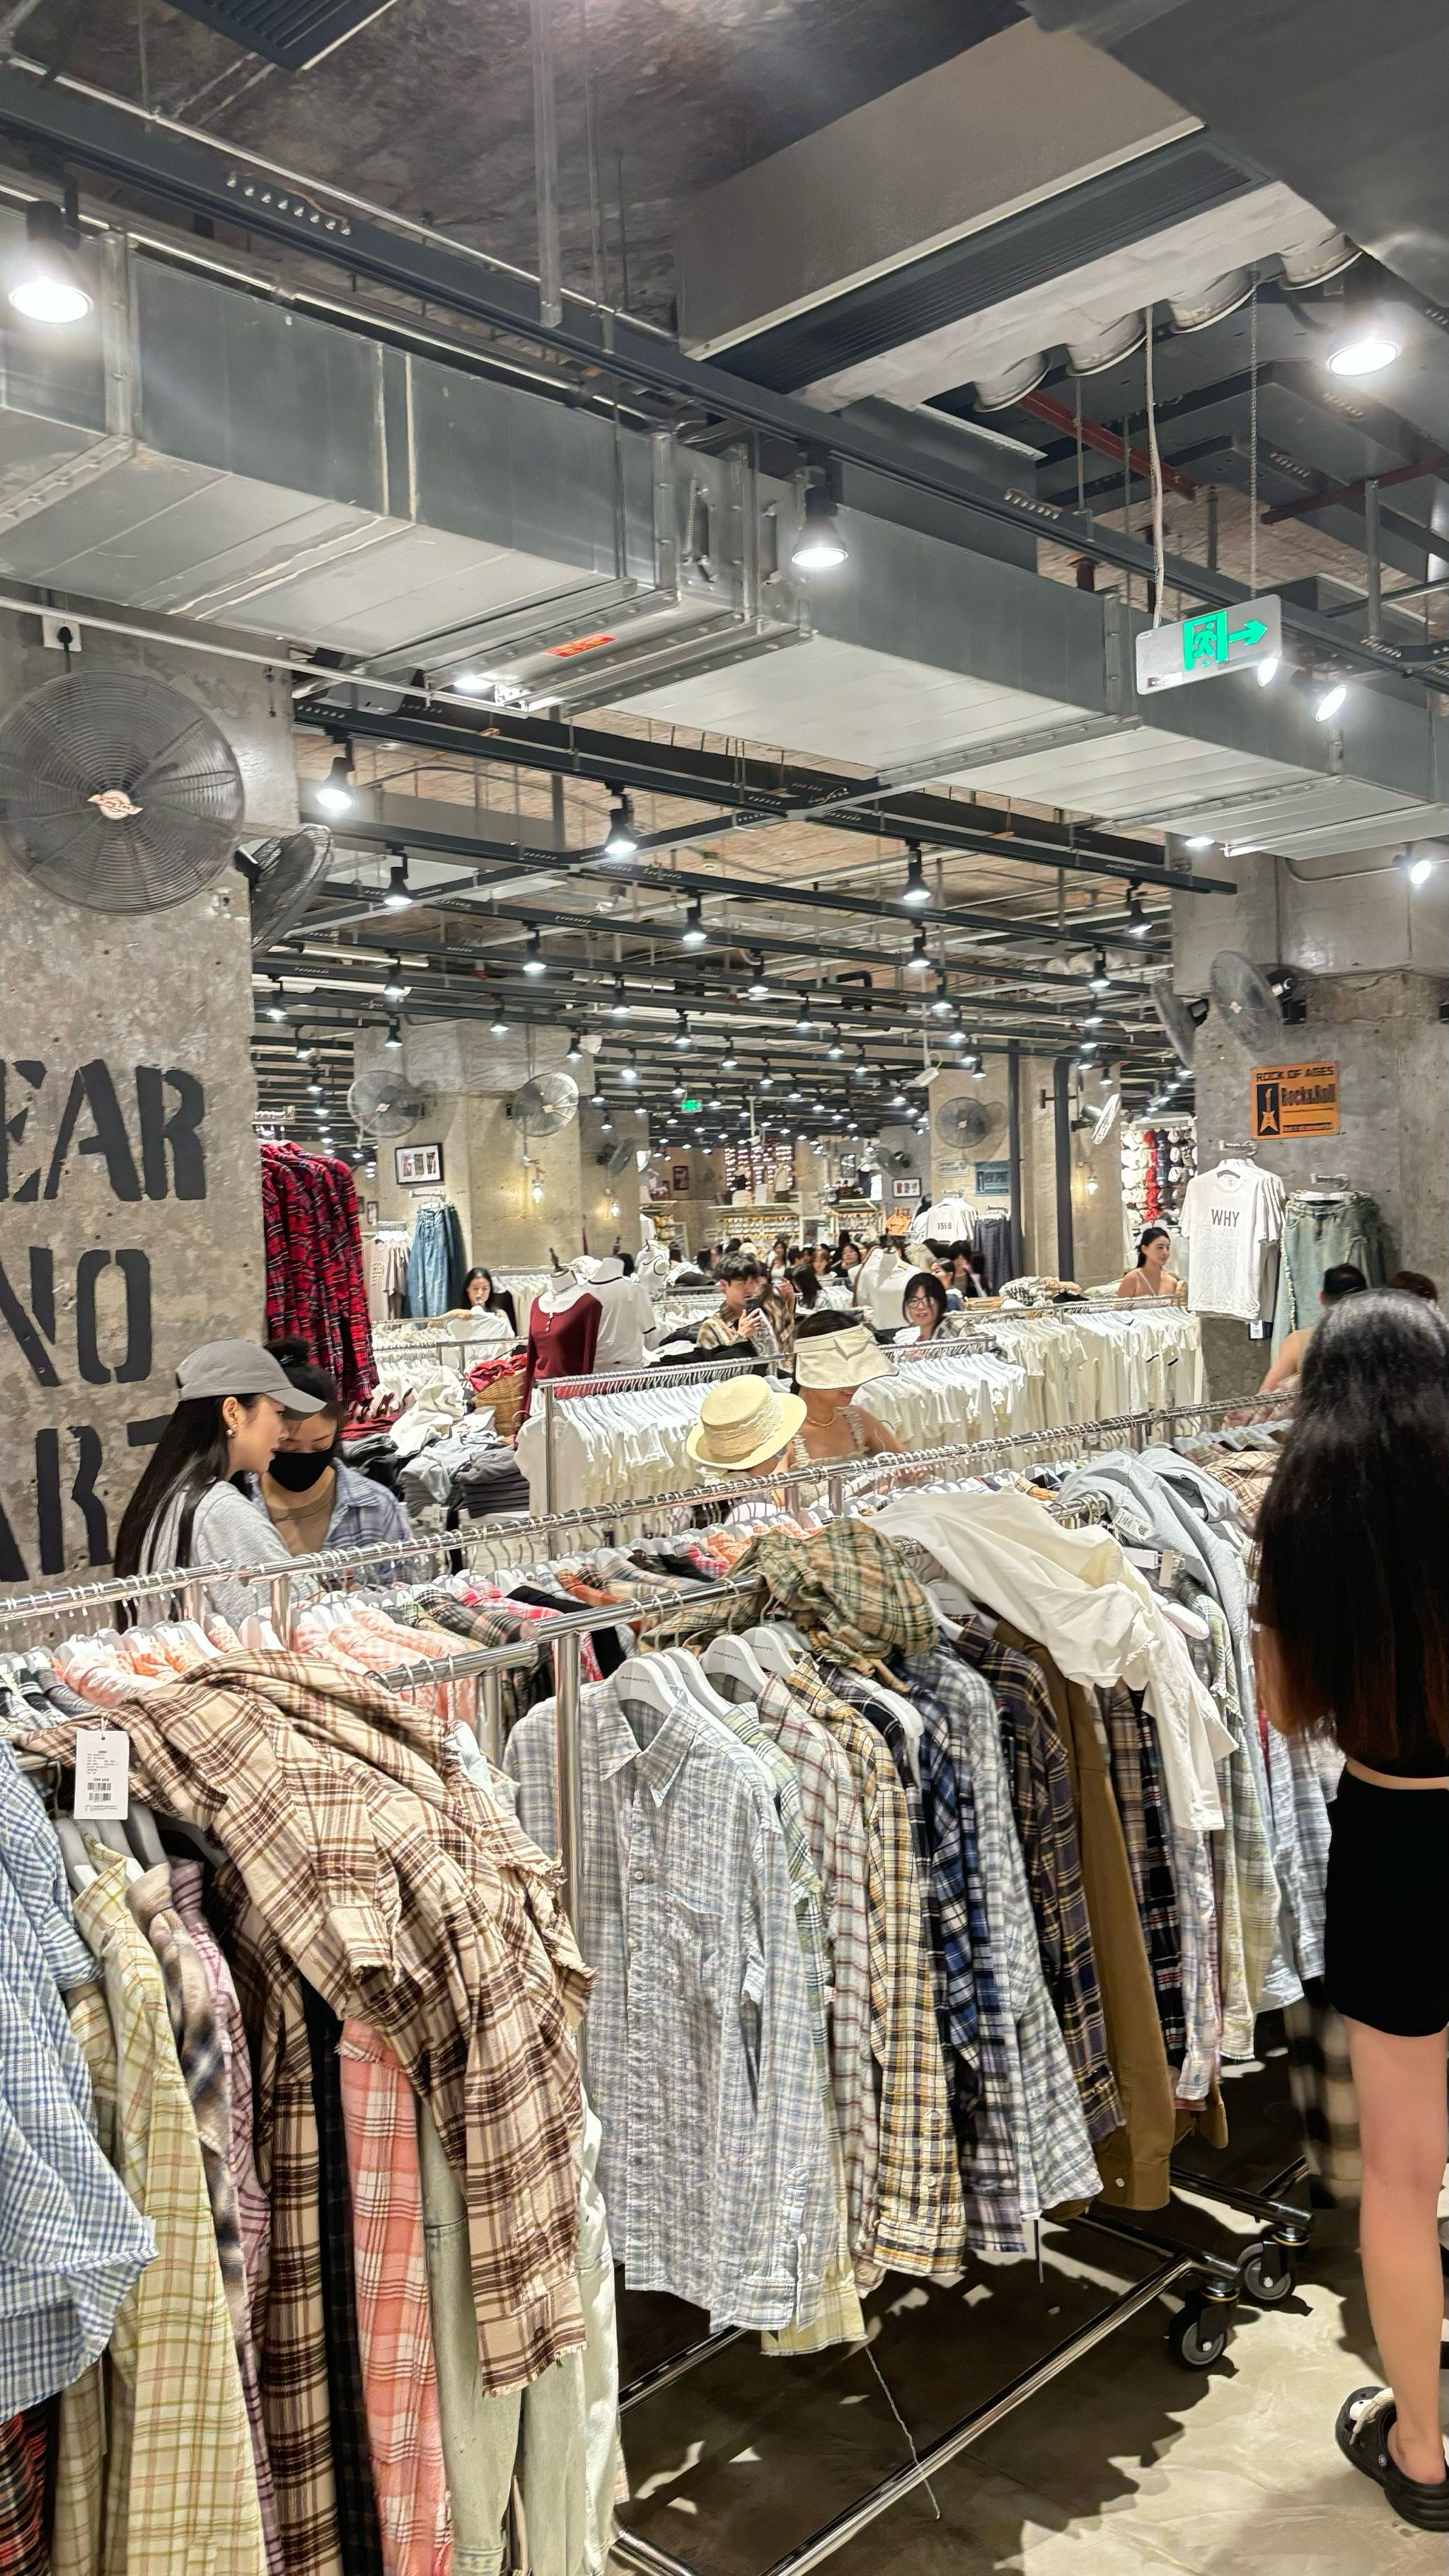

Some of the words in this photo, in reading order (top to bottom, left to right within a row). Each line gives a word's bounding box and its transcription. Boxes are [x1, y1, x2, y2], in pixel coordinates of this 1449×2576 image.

[1256, 1071, 1284, 1082] ROCK
[1287, 1069, 1302, 1079] OF
[1305, 1066, 1334, 1078] AGES
[1211, 1209, 1240, 1228] WHY
